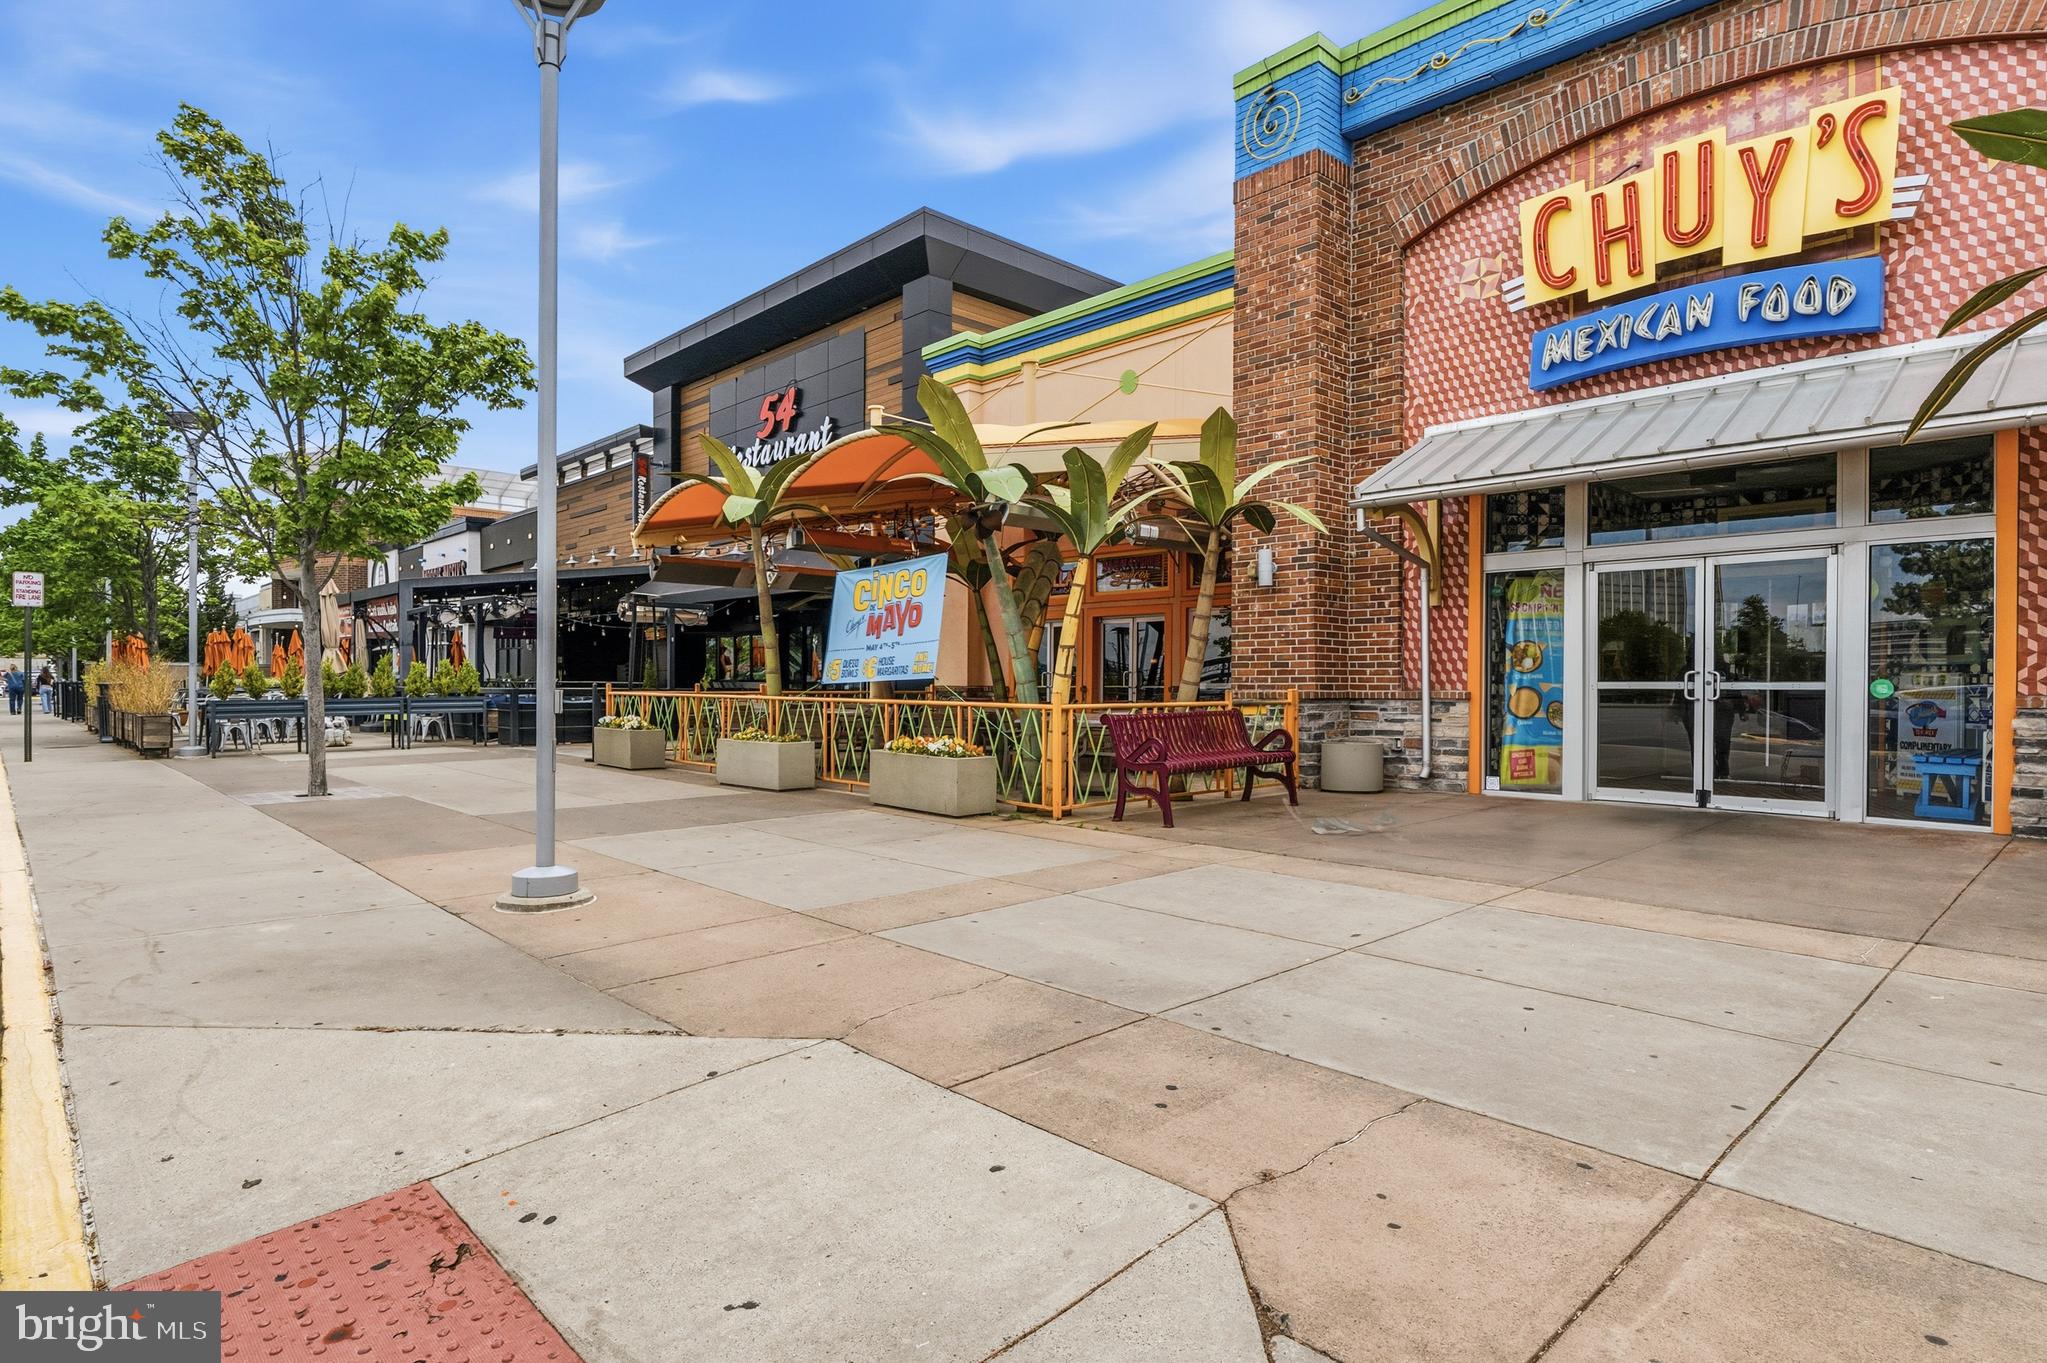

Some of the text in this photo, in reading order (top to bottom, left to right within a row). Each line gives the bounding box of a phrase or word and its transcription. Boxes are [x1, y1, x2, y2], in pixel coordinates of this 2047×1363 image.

[1533, 99, 1888, 290] CHUY'S
[1541, 274, 1857, 371] MEXICAN FOOD
[756, 386, 797, 439] 54
[728, 416, 832, 467] estaurant
[853, 568, 928, 612] CINCO
[866, 597, 923, 640] MAYO
[866, 643, 878, 652] MAY
[878, 655, 896, 666] HOUSE
[841, 668, 859, 678] BOWLS
